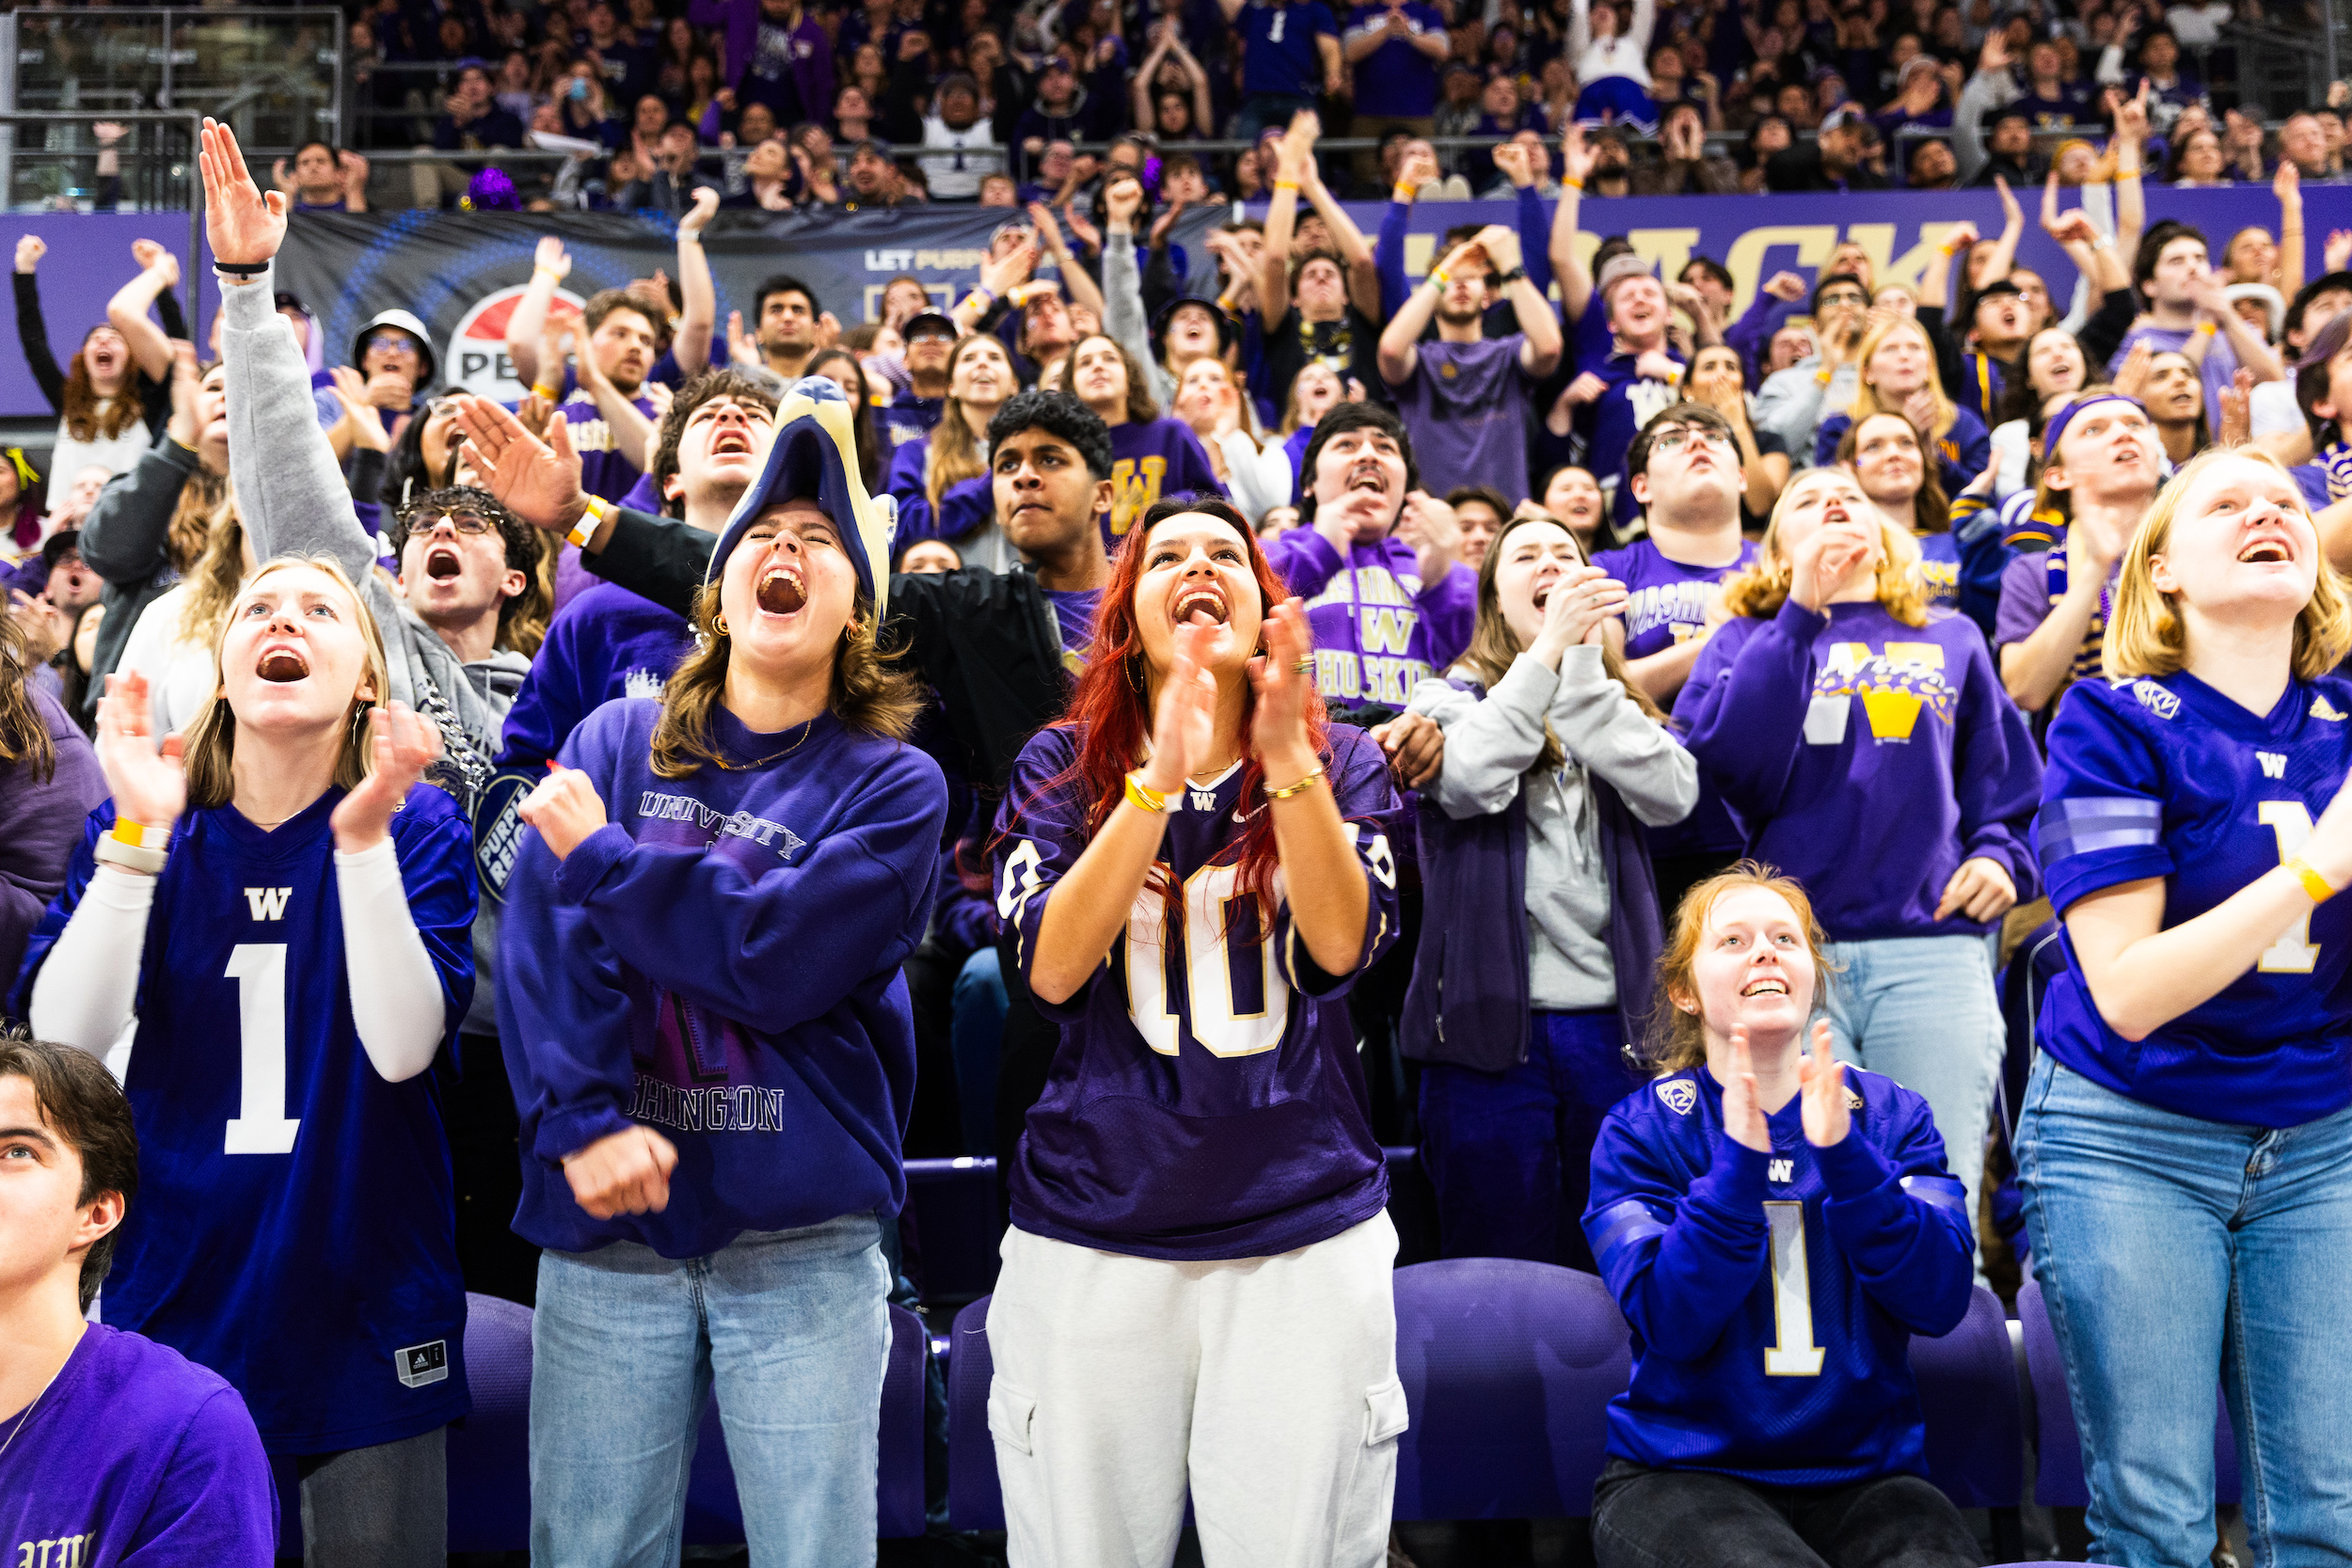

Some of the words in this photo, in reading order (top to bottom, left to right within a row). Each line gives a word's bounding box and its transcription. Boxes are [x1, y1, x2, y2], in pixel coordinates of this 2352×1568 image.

[864, 249, 914, 271] LET
[914, 248, 984, 270] PURP
[1109, 455, 1167, 535] W
[1347, 605, 1419, 656] W
[1313, 648, 1436, 706] HUSKI
[2255, 751, 2289, 779] W
[1190, 791, 1217, 812] W
[244, 887, 293, 921] W
[2257, 800, 2322, 974] 1
[1124, 862, 1290, 1059] 10
[224, 942, 301, 1155] 1
[1670, 1093, 1690, 1107] 12
[1768, 1158, 1794, 1182] W
[1761, 1200, 1826, 1376] 1
